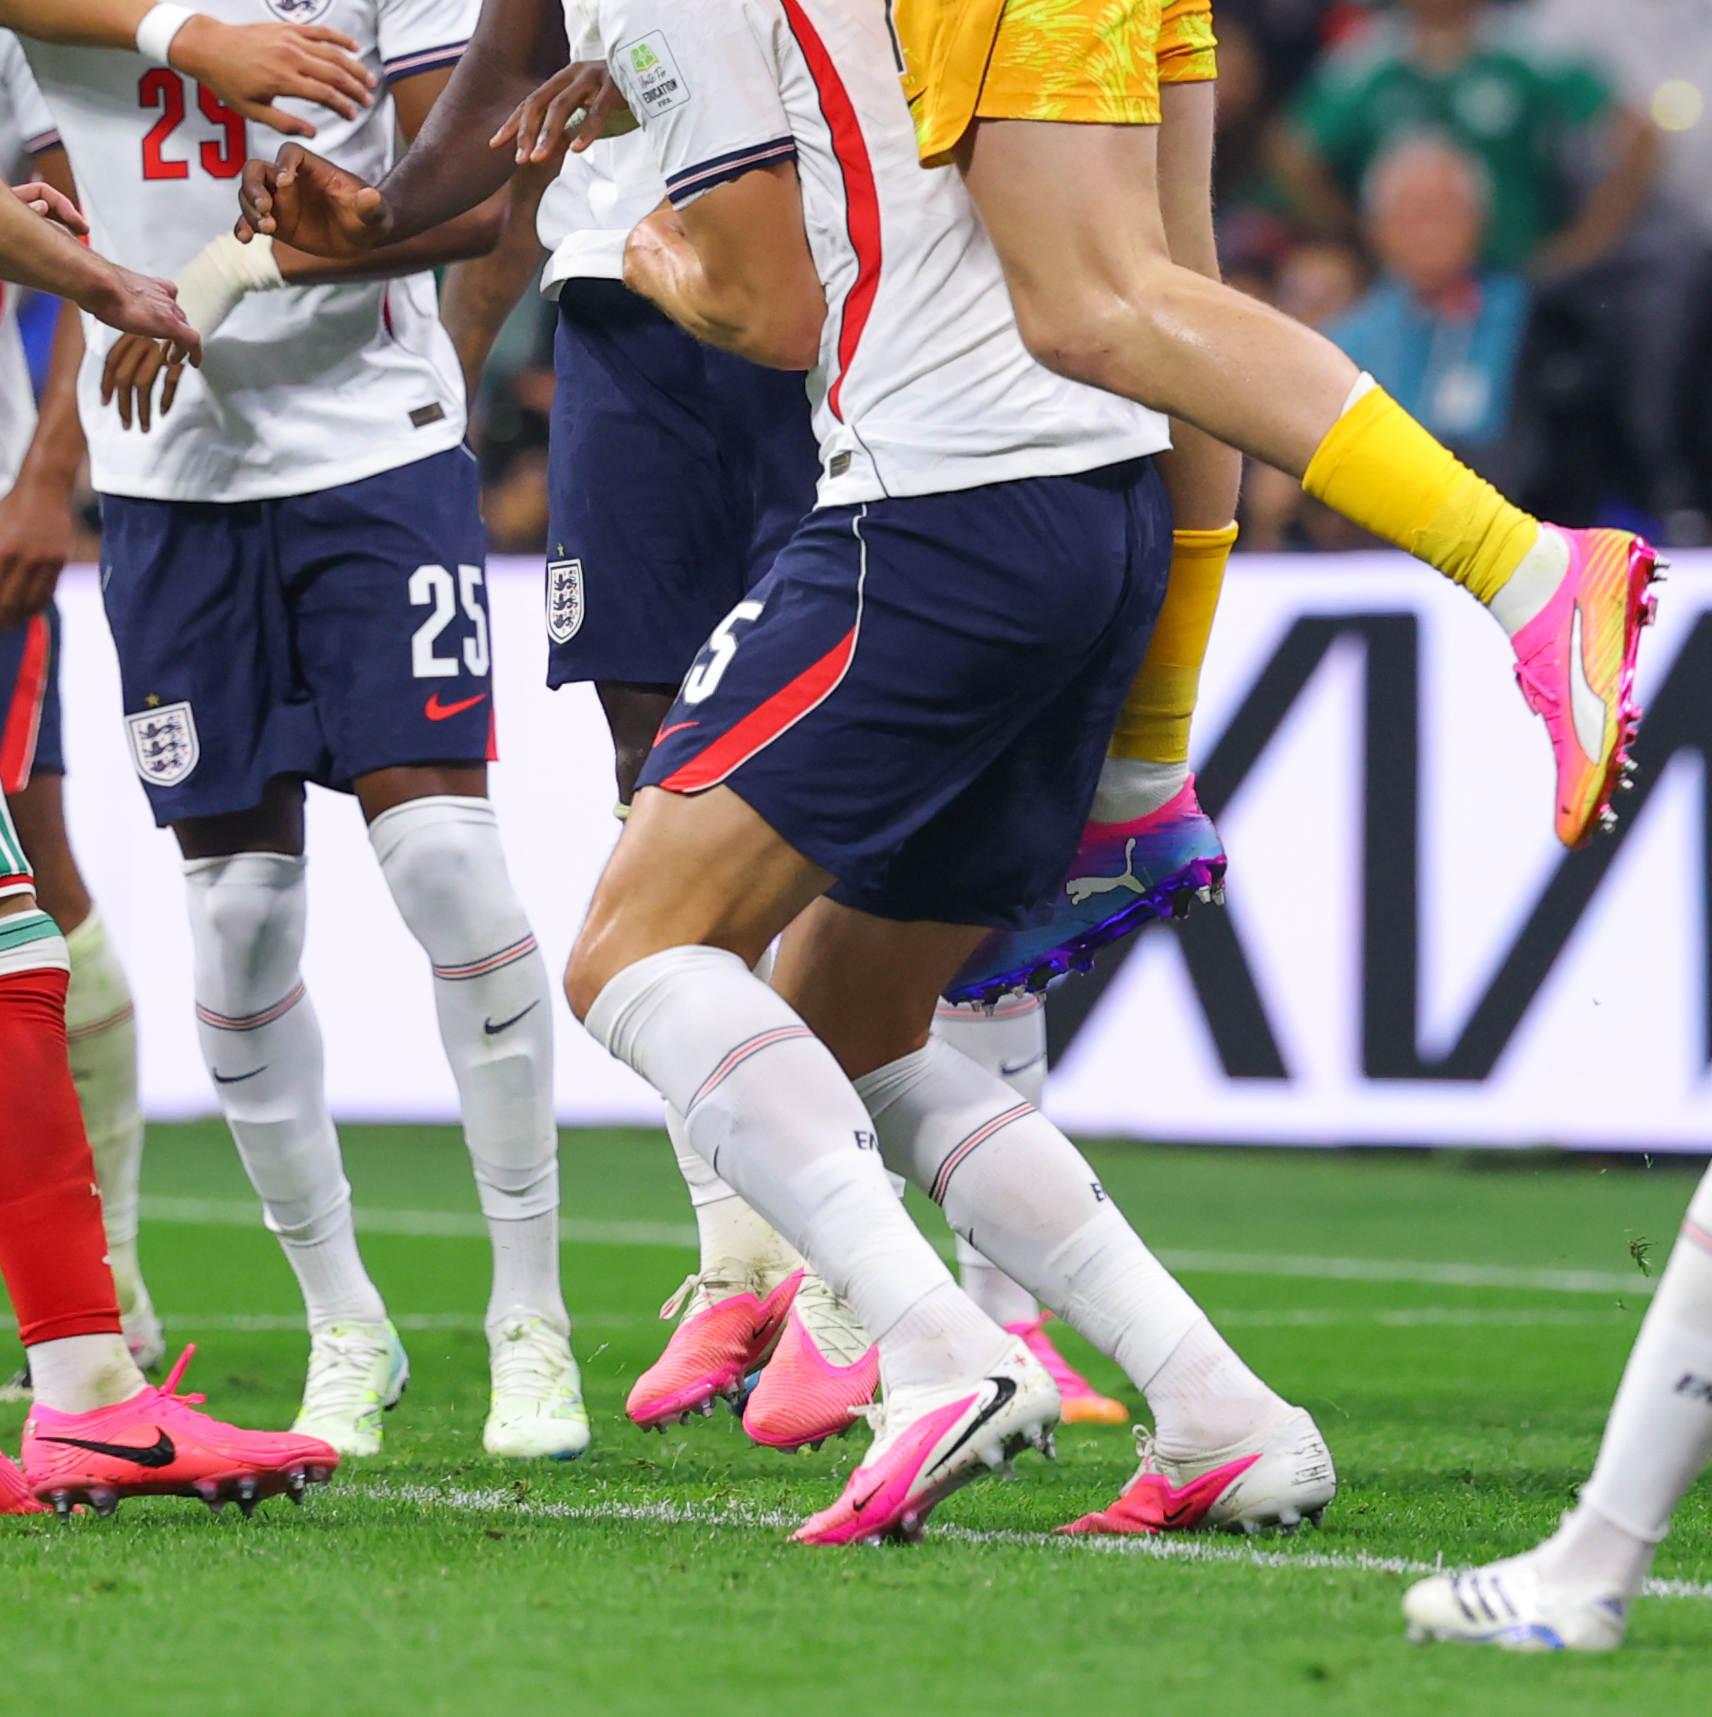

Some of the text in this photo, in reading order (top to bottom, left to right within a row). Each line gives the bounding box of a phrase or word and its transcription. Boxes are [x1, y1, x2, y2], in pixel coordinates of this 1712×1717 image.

[138, 67, 248, 181] 25
[642, 77, 678, 104] EDUCATION
[408, 563, 490, 679] 25
[682, 598, 767, 705] 5
[853, 1130, 882, 1151] EN
